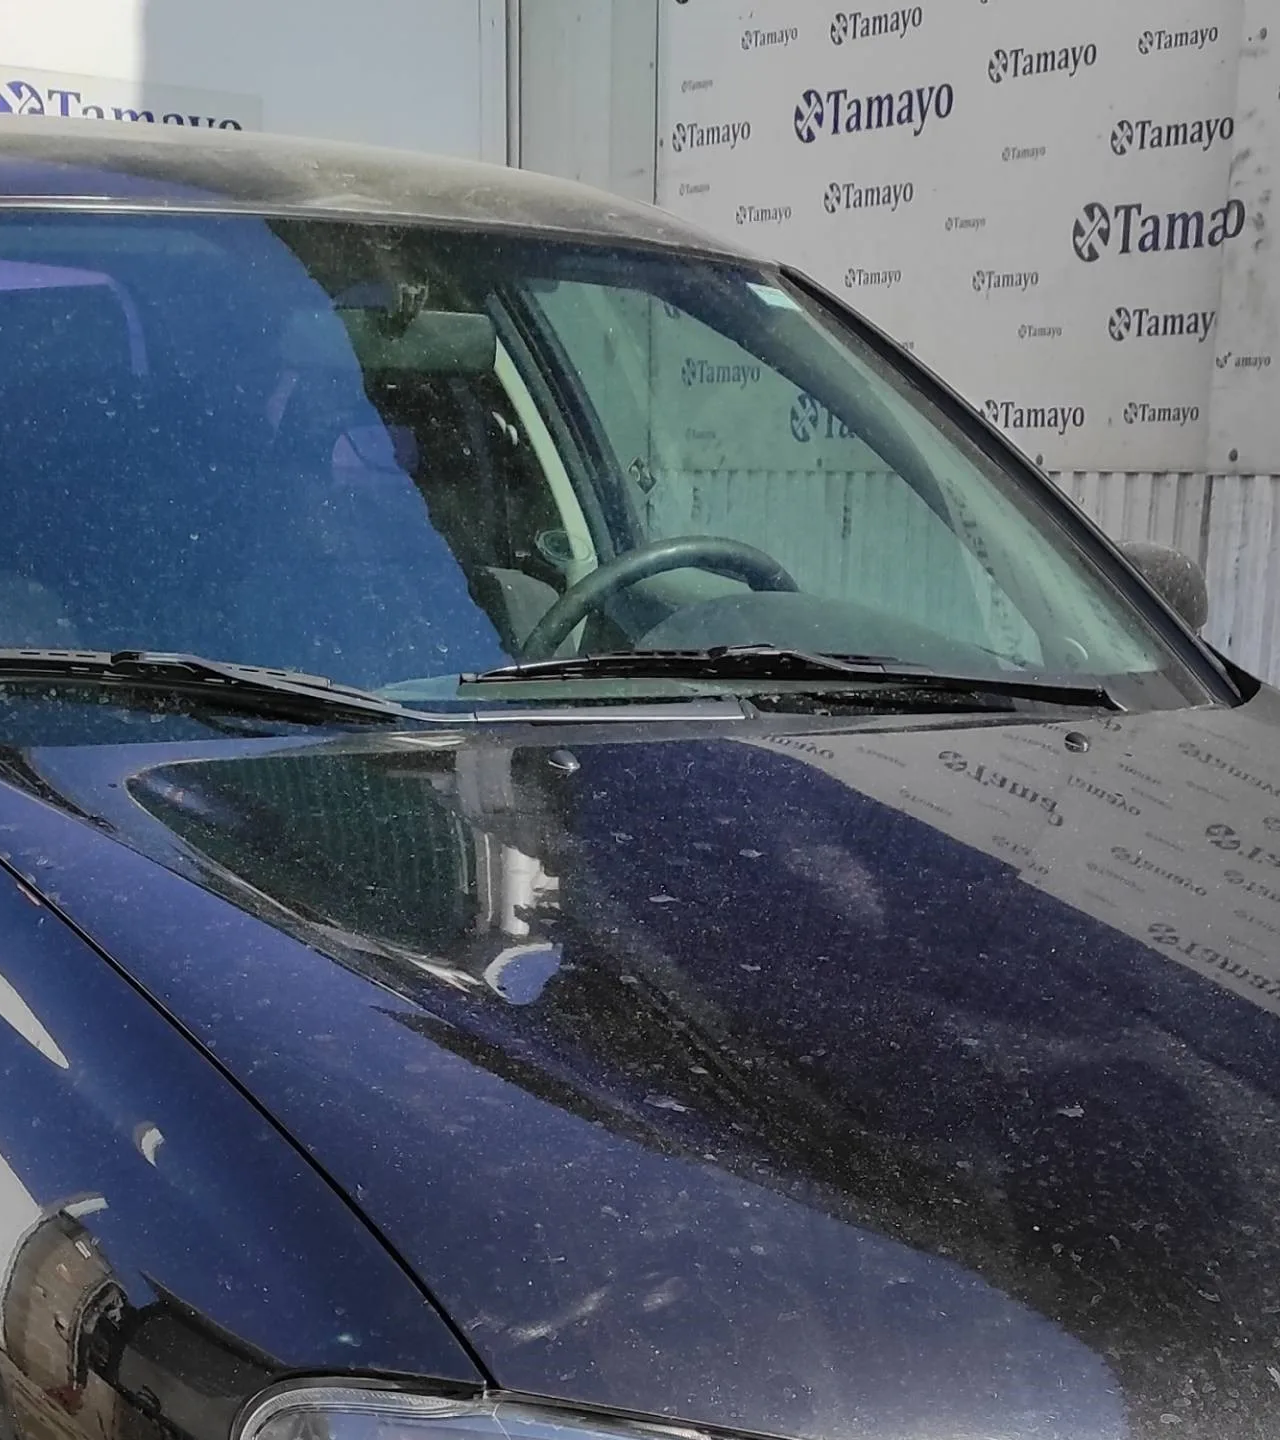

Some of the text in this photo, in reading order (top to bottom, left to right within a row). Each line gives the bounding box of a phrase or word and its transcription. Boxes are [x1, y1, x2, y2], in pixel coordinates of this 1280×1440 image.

[849, 7, 922, 39] Tamayo
[1155, 27, 1218, 49] Tamayo
[1010, 44, 1096, 77] Tamayo
[827, 84, 953, 136] Tamayo
[687, 122, 750, 149] Tamayo
[1136, 117, 1234, 151] Tamayo
[843, 183, 913, 211] Tamayo
[748, 206, 791, 224] Tamayo
[854, 269, 901, 288] Tamayo
[984, 271, 1038, 291] Tamayo
[1028, 325, 1062, 338] Tamayo
[1133, 309, 1216, 342] Tamay
[697, 359, 760, 388] Tamayo
[1235, 356, 1271, 370] amayo
[999, 401, 1085, 435] Tamayo
[1139, 404, 1199, 426] Tamayo
